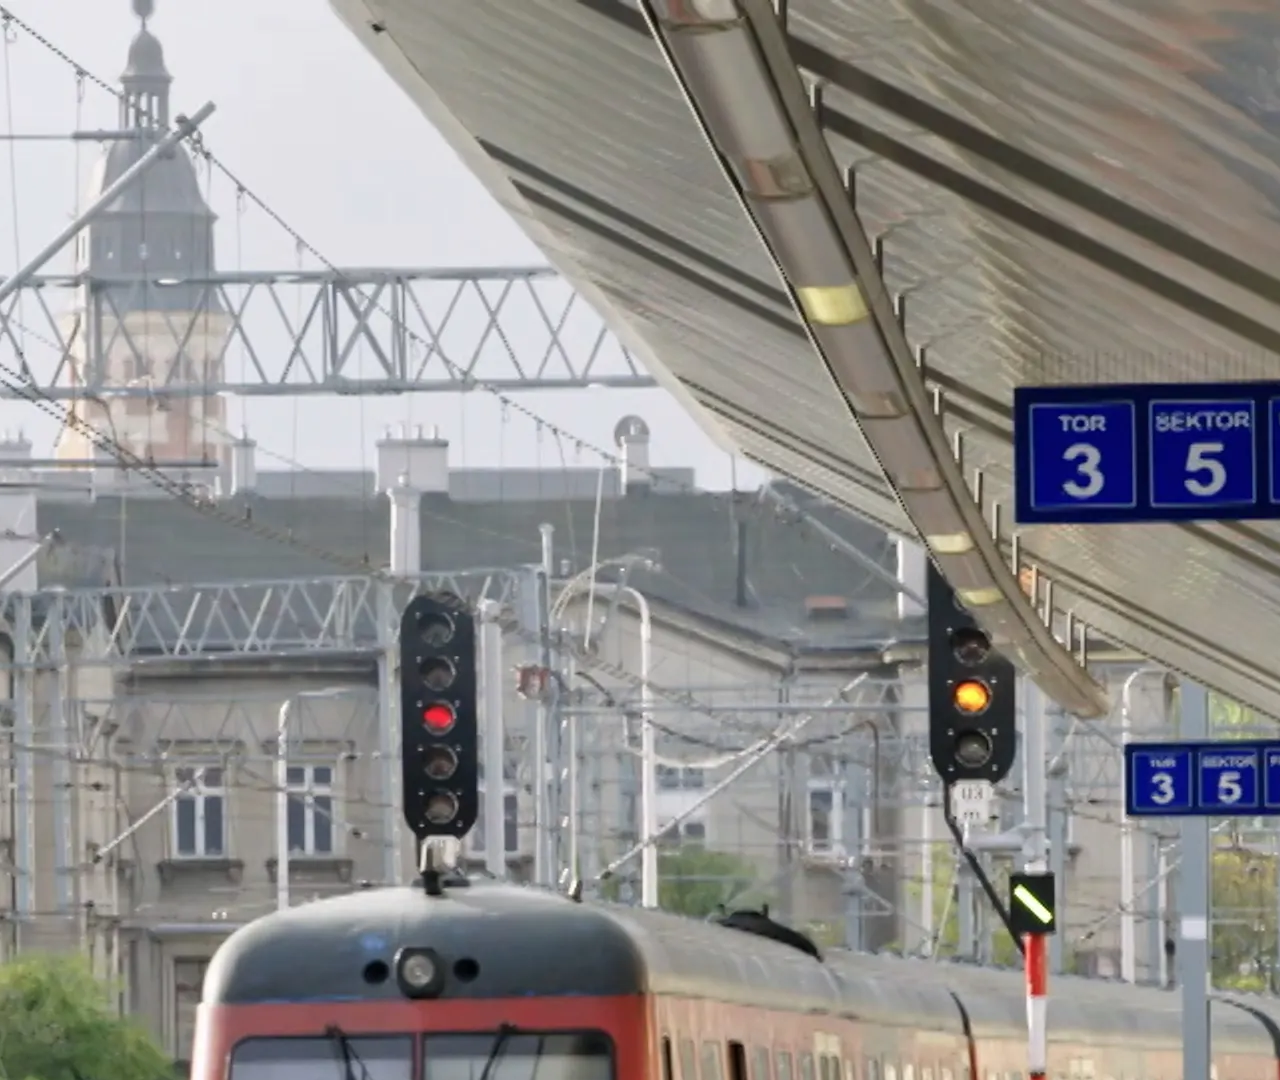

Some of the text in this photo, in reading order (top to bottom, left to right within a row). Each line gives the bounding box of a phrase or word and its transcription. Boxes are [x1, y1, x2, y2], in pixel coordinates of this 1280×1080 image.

[1058, 414, 1107, 432] TOR
[1155, 411, 1251, 432] SEKTOR
[1062, 443, 1105, 498] 3
[1184, 442, 1227, 496] 5
[1150, 772, 1175, 804] 3
[1218, 771, 1242, 804] 5
